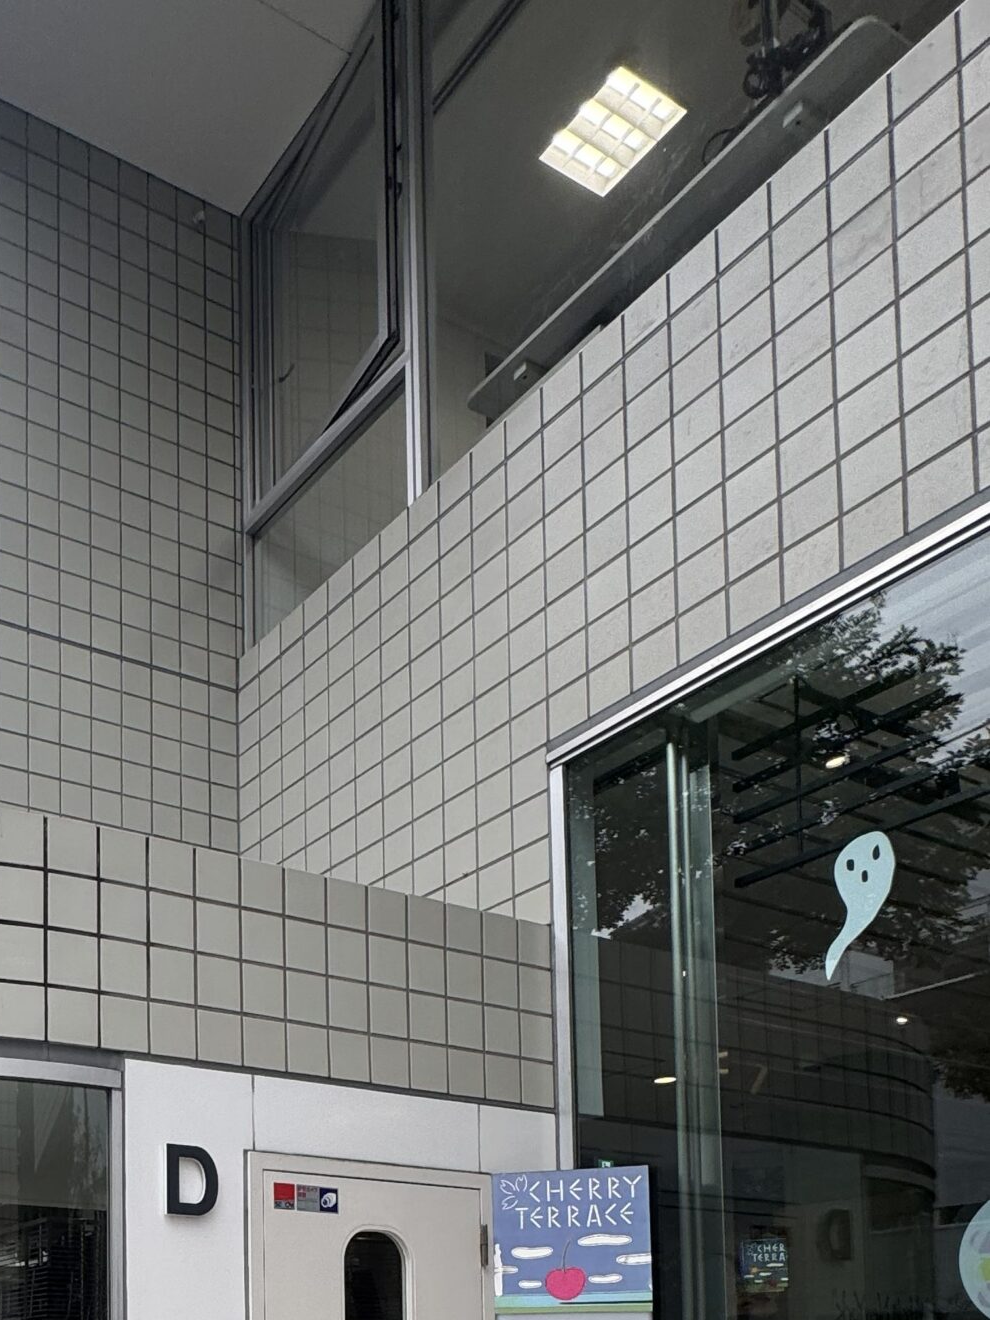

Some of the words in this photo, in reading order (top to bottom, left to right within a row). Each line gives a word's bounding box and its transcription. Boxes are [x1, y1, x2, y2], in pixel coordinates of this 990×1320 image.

[166, 1143, 219, 1216] D
[529, 1175, 642, 1202] CHERRY
[515, 1202, 634, 1229] TERRACE
